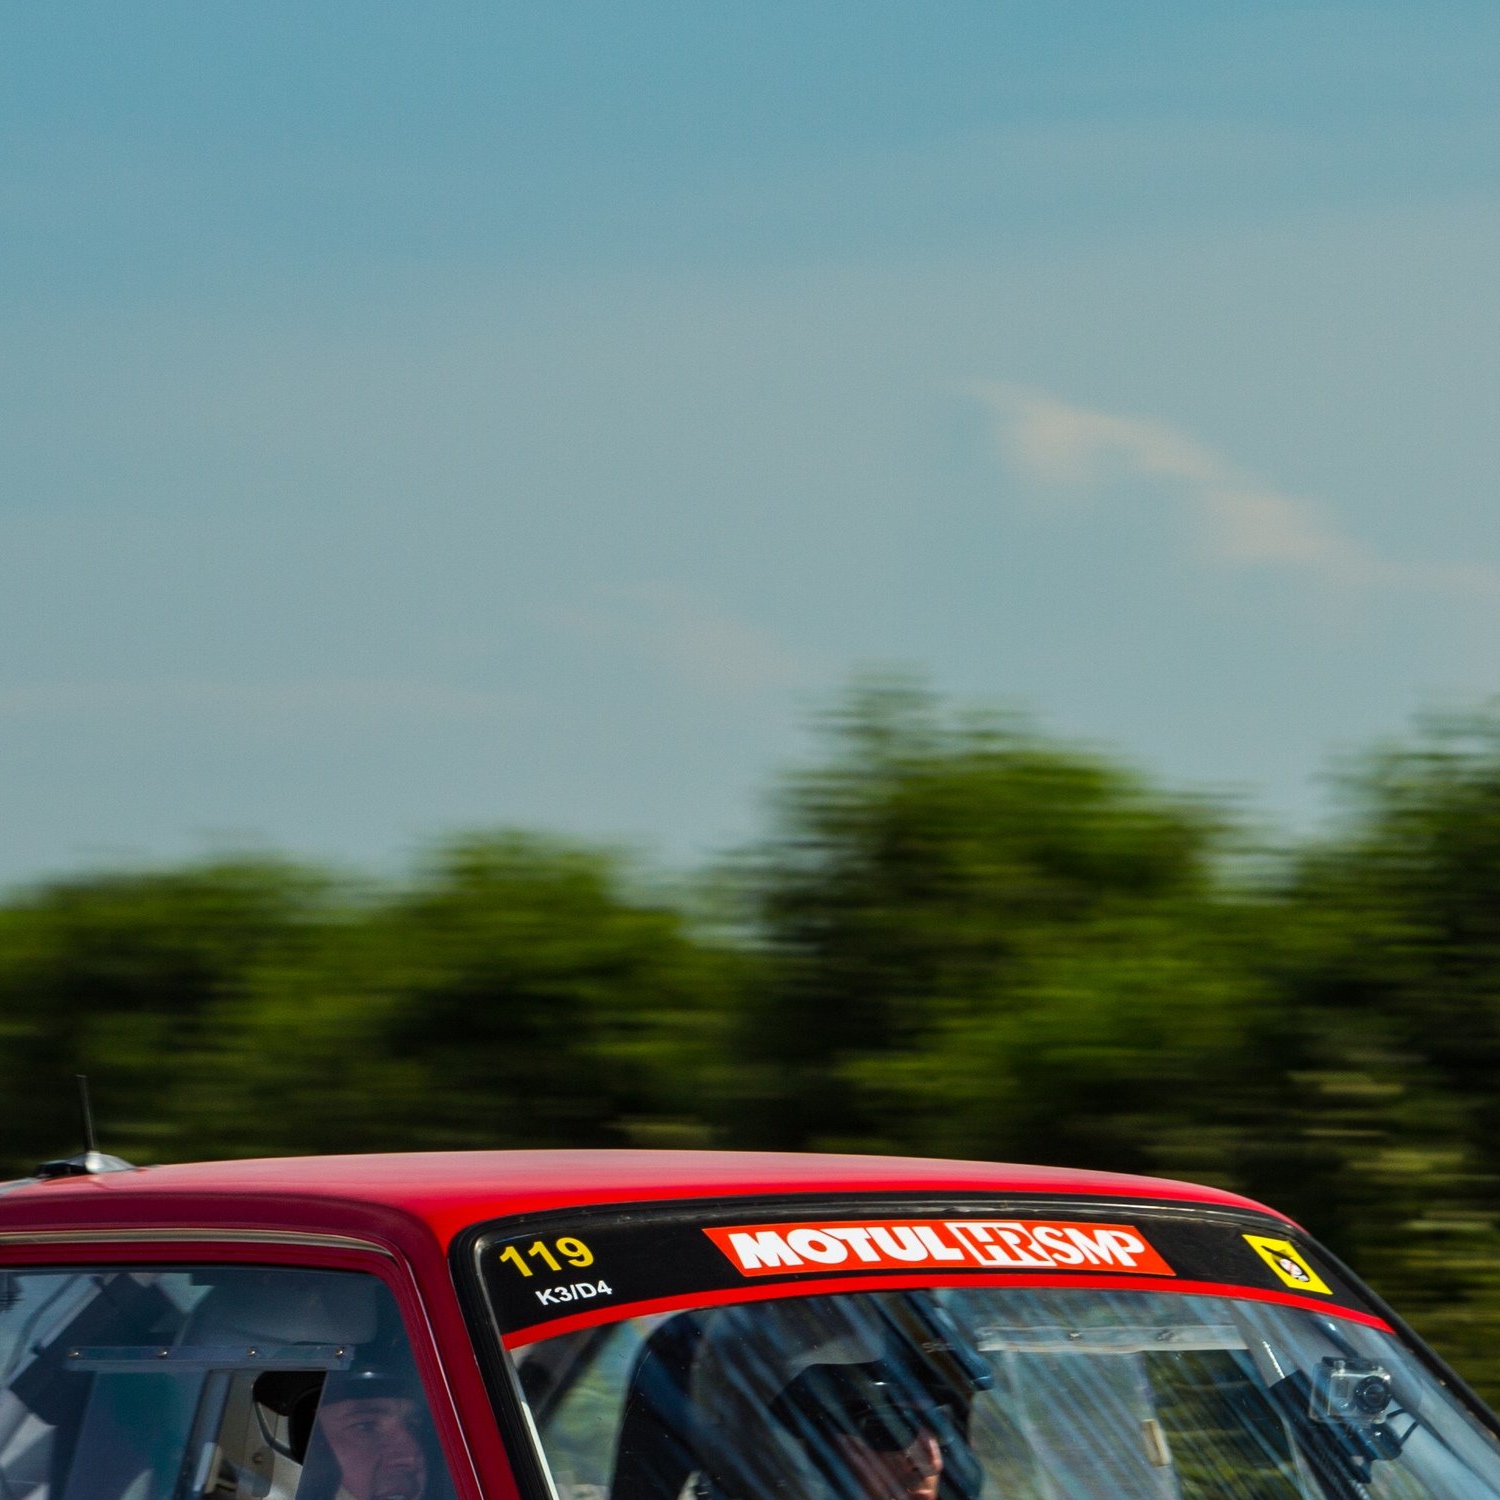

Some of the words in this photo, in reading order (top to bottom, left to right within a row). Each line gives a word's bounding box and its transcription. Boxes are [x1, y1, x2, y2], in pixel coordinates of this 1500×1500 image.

[499, 1236, 595, 1278] 119
[728, 1226, 964, 1270] MOTUL
[535, 1280, 613, 1306] K3/D4
